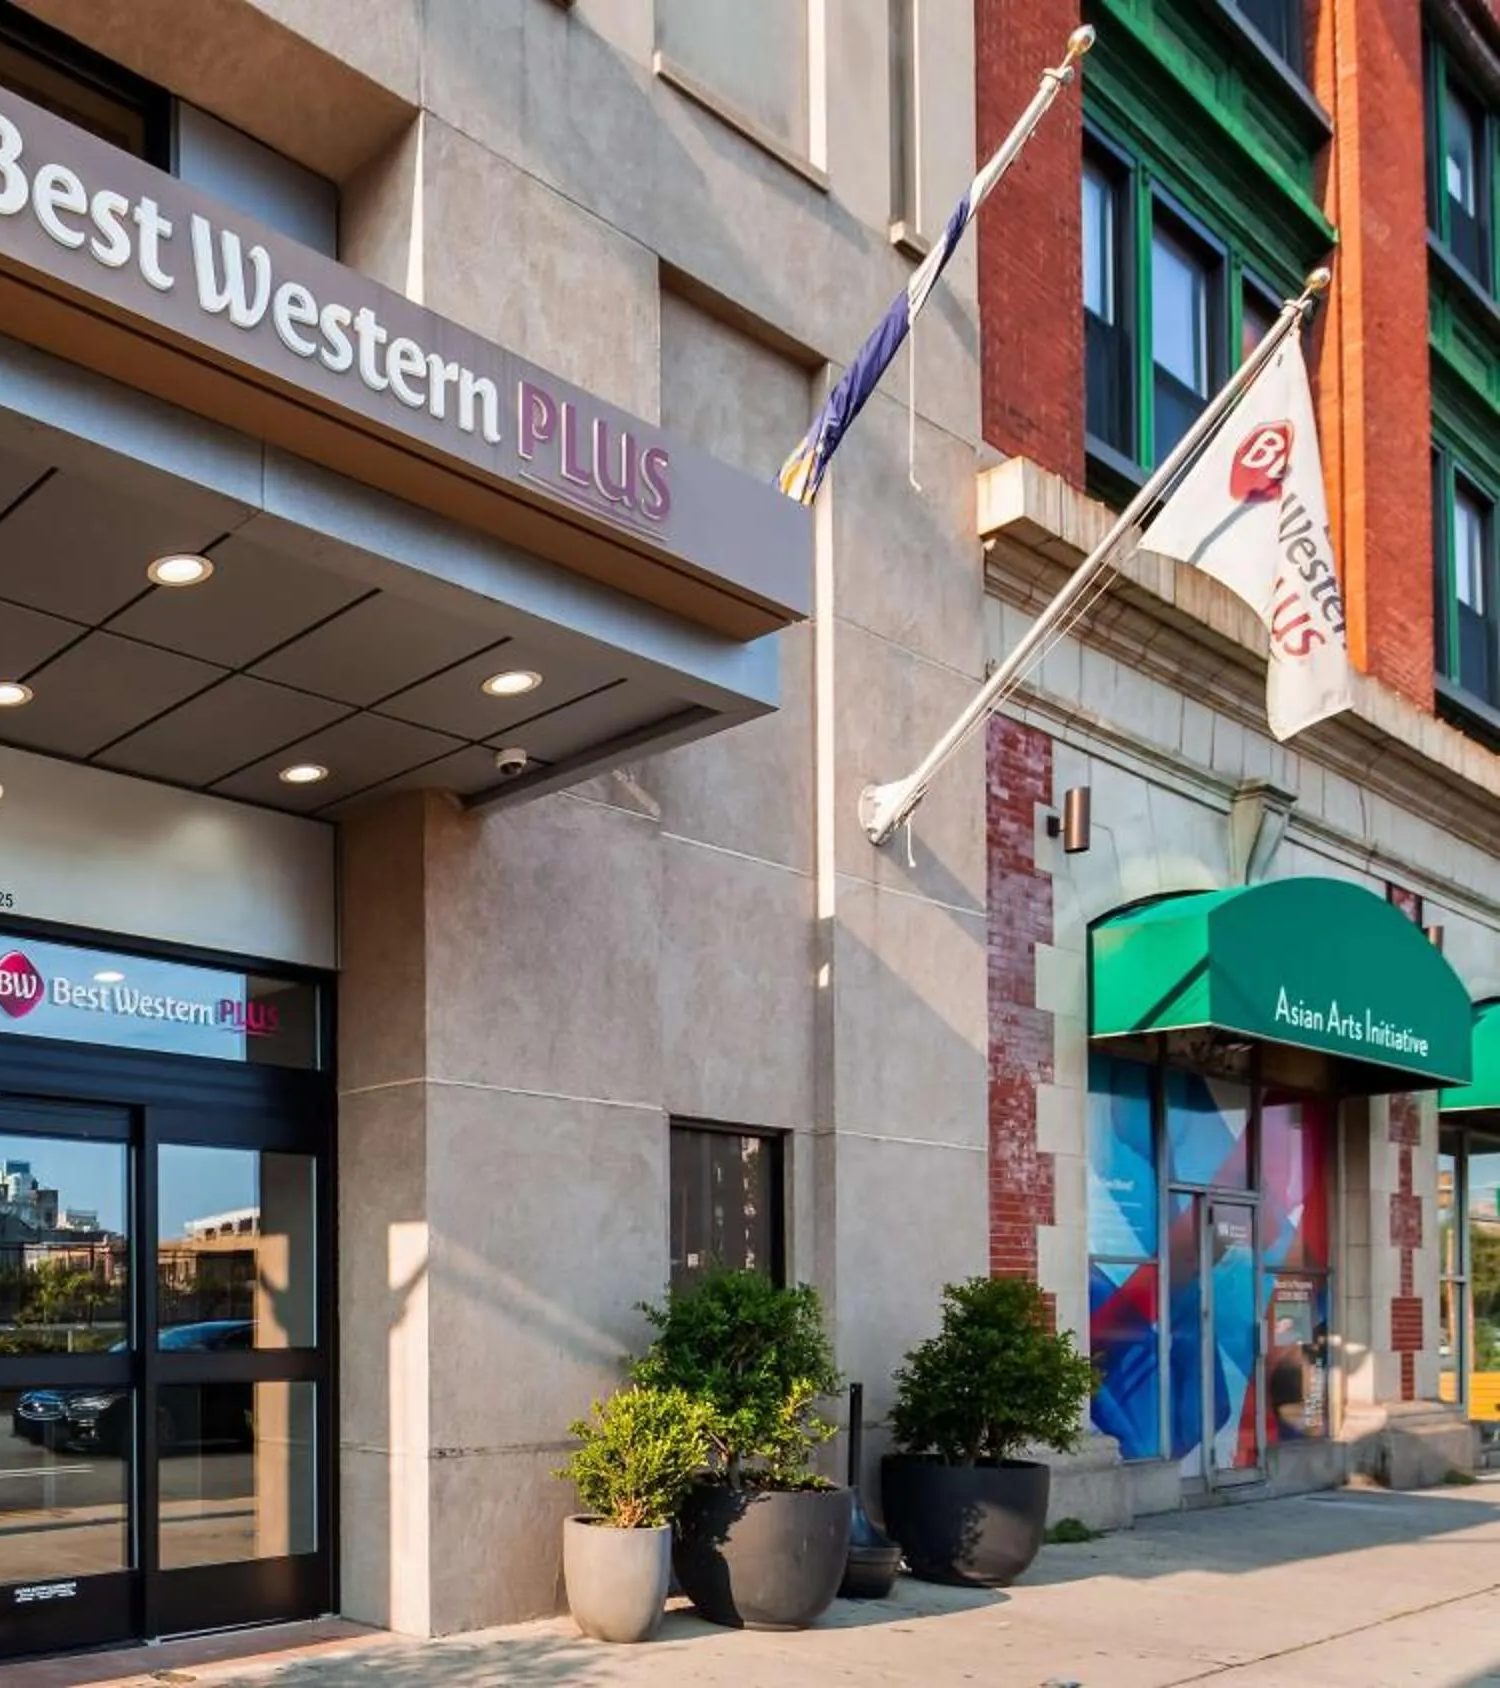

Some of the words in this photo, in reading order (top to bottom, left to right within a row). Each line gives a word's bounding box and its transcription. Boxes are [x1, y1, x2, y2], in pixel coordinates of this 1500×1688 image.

[190, 213, 503, 445] Western
[518, 380, 671, 522] PLUS
[51, 977, 111, 1012] Best
[114, 986, 214, 1025] Western
[219, 999, 279, 1030] PLUS
[1275, 985, 1323, 1032] Asian
[1326, 1000, 1363, 1041] Arts
[1365, 1008, 1429, 1057] Initiative
